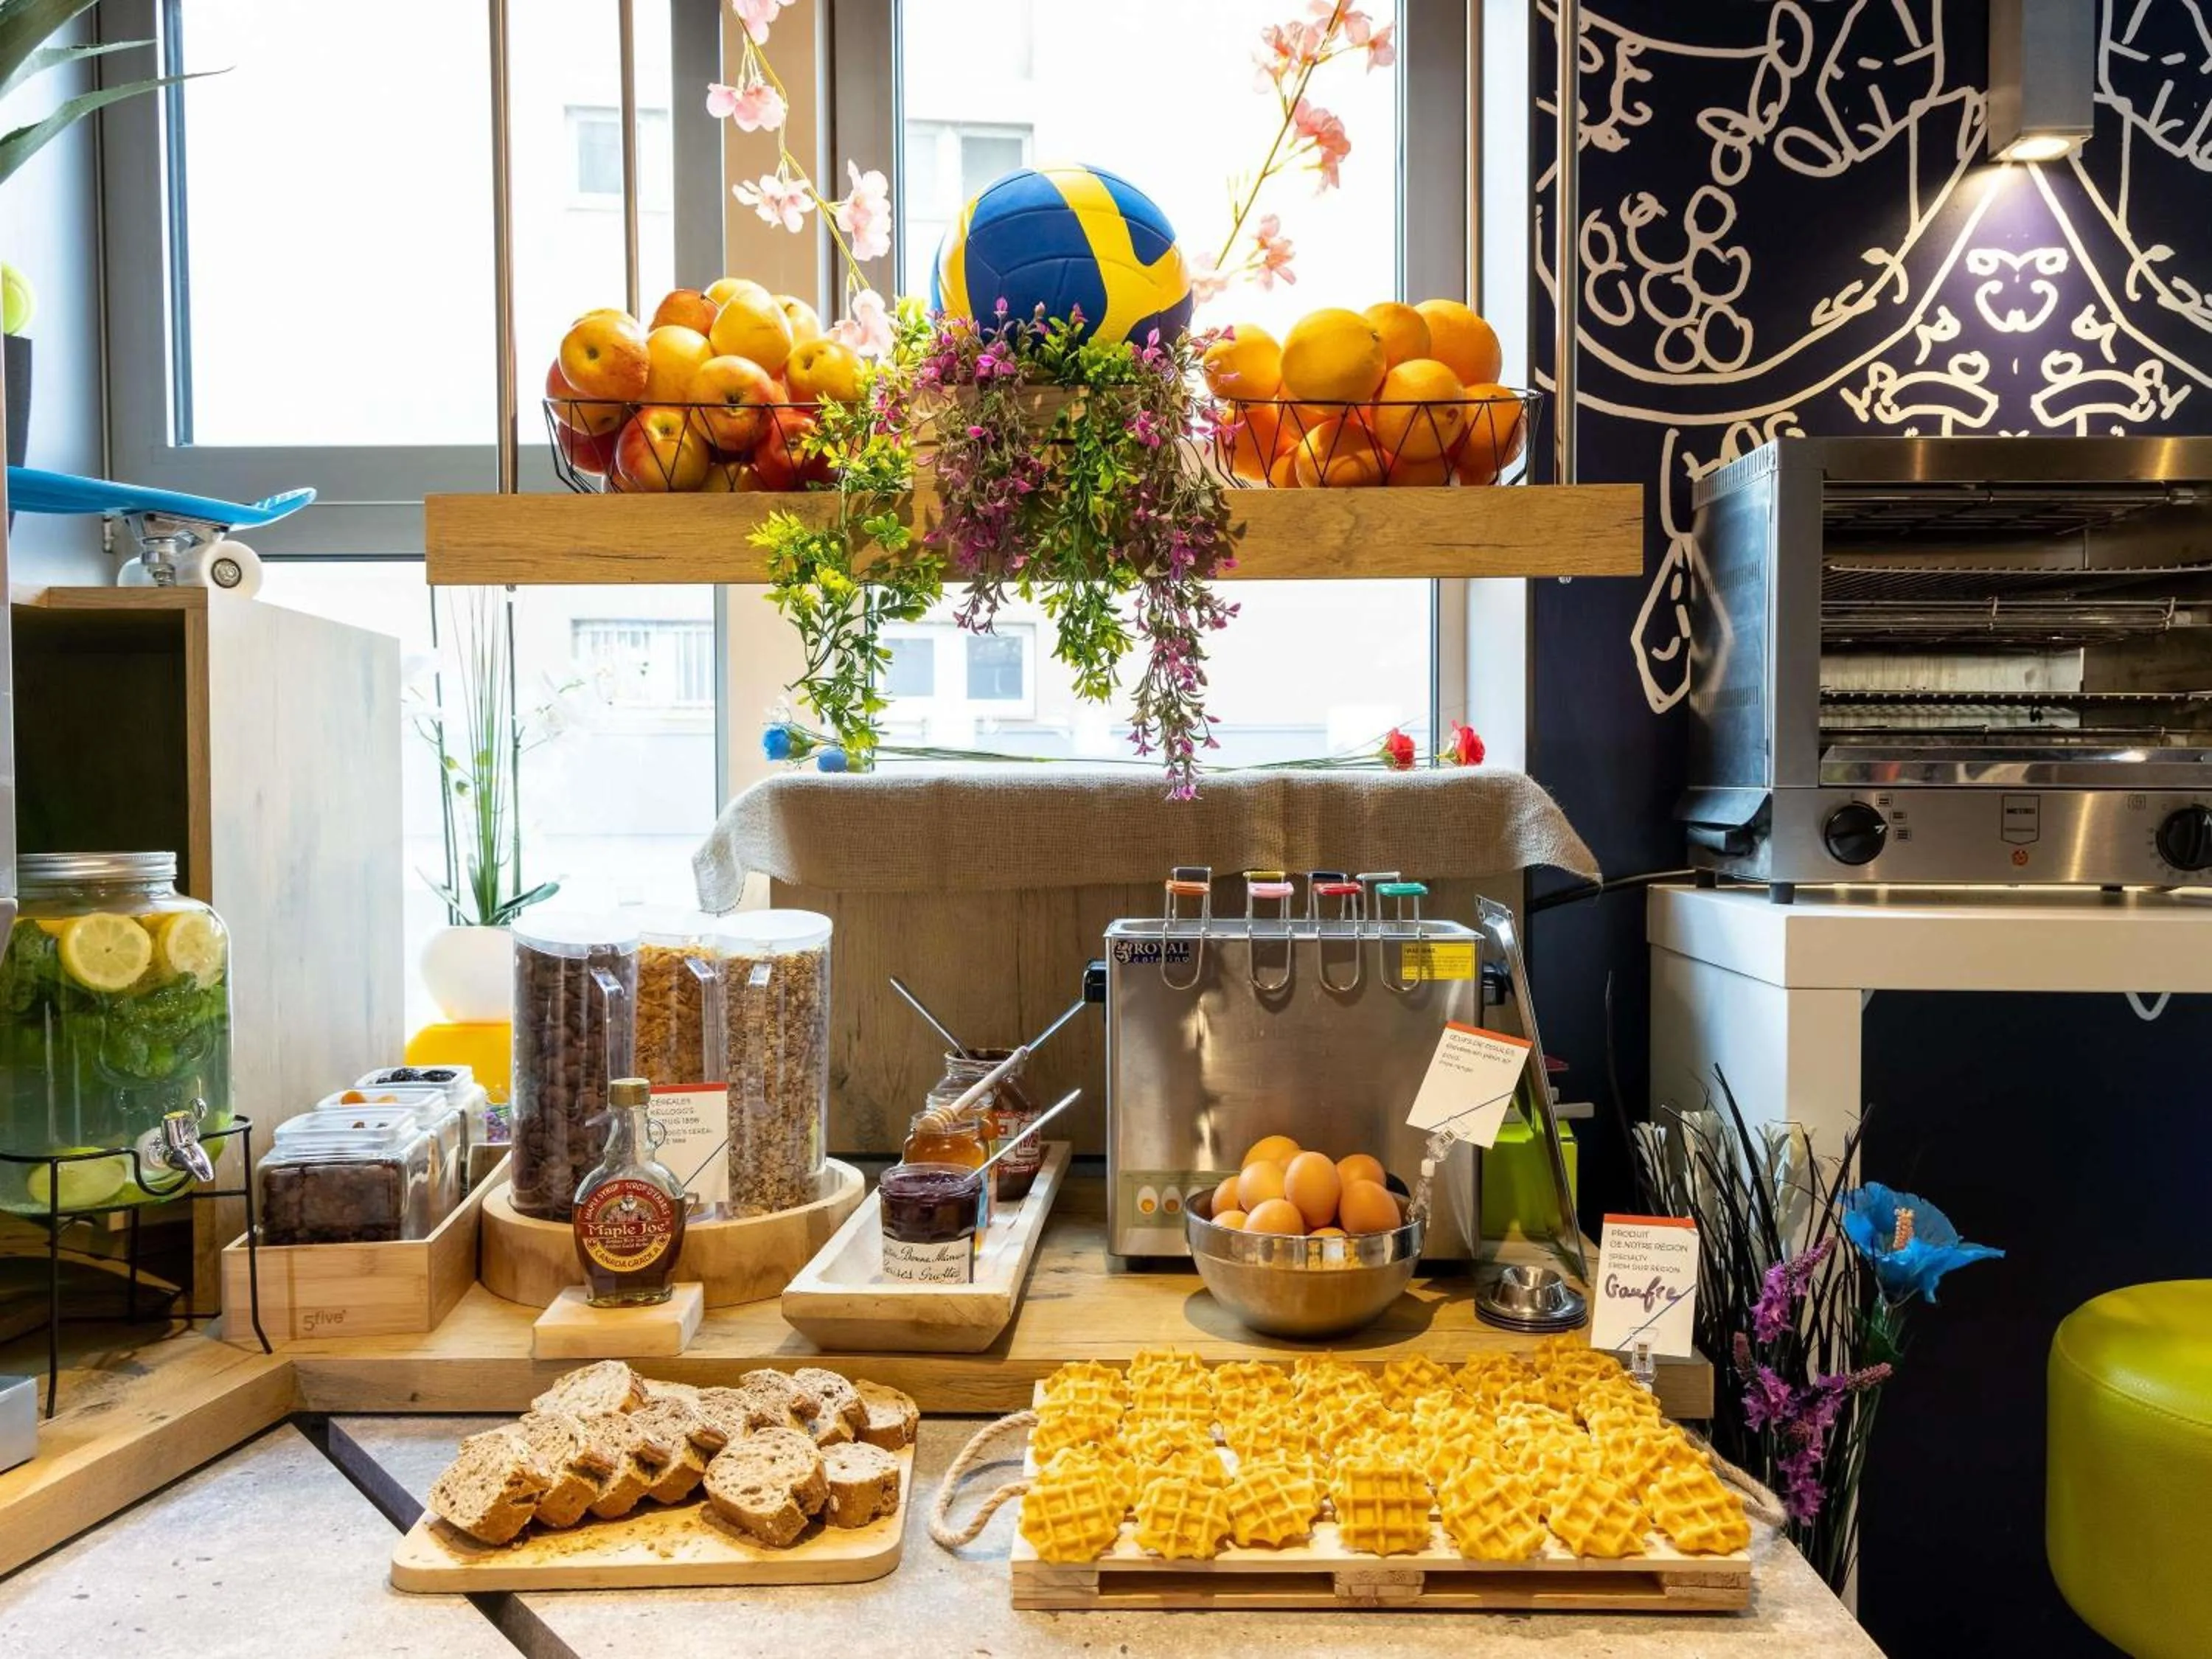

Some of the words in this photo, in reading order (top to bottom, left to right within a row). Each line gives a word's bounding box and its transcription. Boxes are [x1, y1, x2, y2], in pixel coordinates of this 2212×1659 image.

[1133, 955, 1189, 963] cateing
[588, 1223, 637, 1238] Maple
[641, 1222, 667, 1235] Joe
[1611, 1228, 1650, 1239] PRODUIT
[1610, 1240, 1622, 1248] DE
[1624, 1240, 1652, 1251] NOTRE
[1608, 1253, 1649, 1262] SPECIALTY
[1608, 1262, 1630, 1270] FROM
[1650, 1264, 1681, 1273] REGION
